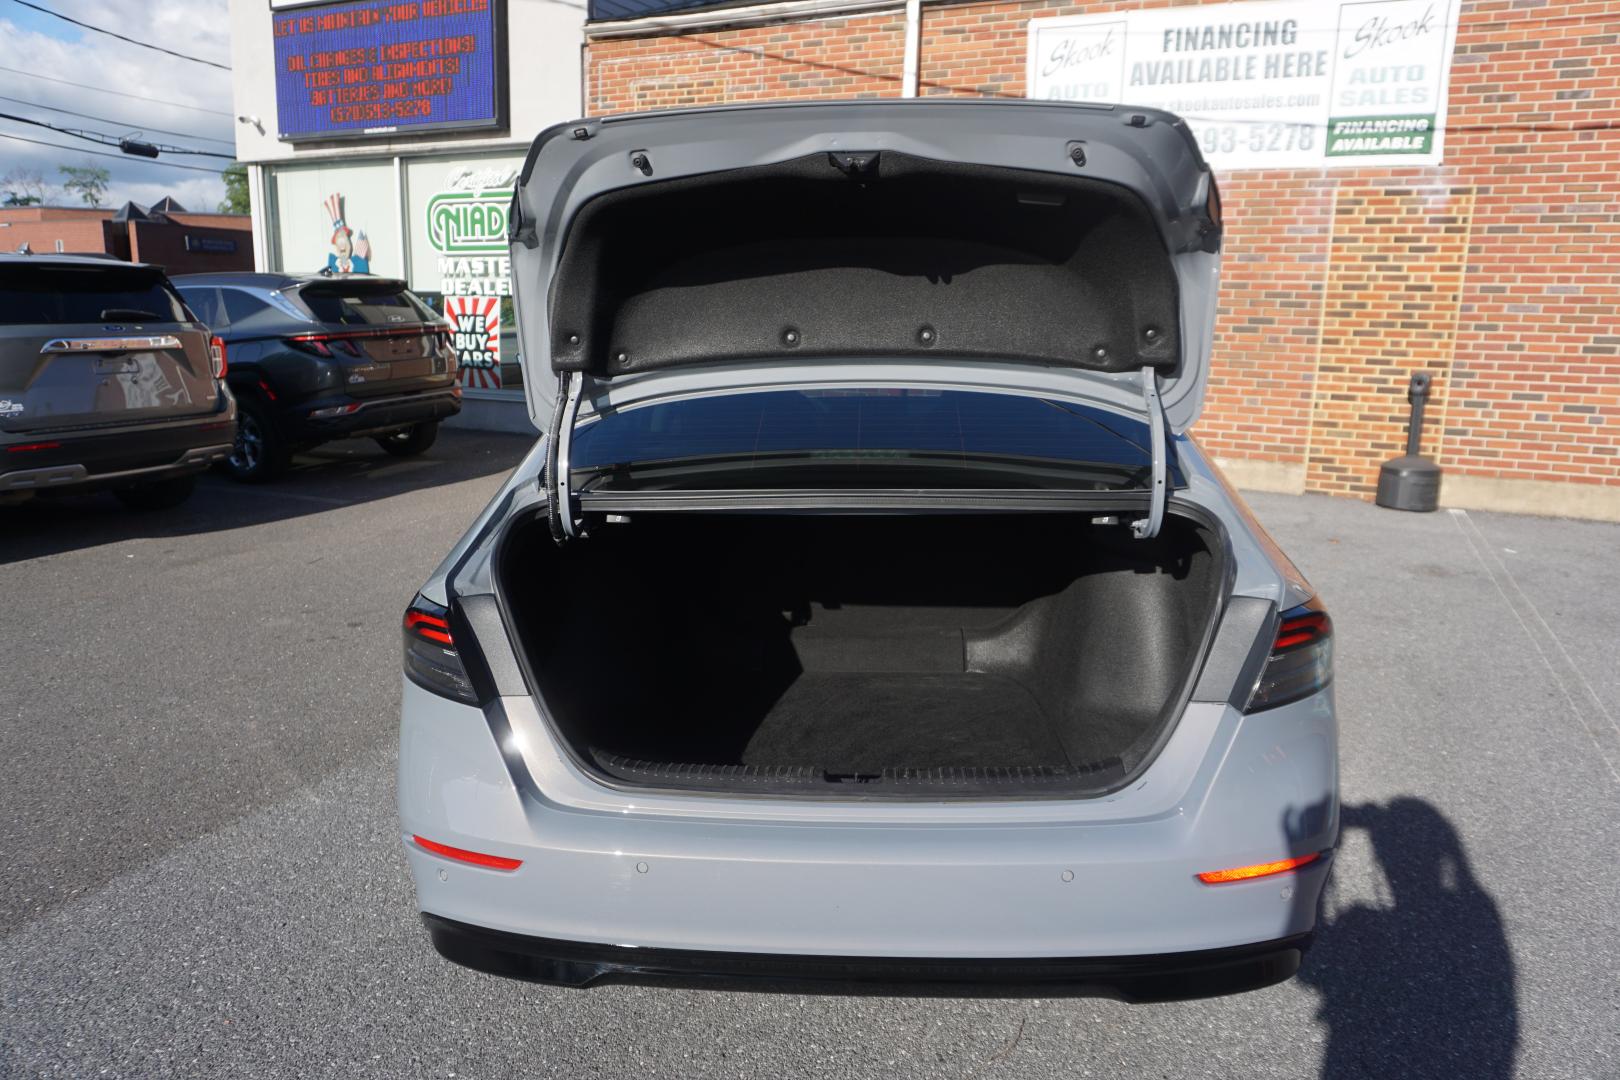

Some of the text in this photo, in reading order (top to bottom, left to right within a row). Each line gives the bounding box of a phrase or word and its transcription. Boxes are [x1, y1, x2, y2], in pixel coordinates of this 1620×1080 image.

[273, 18, 296, 36] LET
[384, 3, 419, 25] YOUR
[1163, 19, 1298, 52] FINANCING
[1343, 3, 1435, 59] Skook
[310, 48, 365, 69] CHANGES
[1042, 28, 1115, 77] Skook
[344, 67, 369, 85] AND
[1130, 50, 1328, 86] AVAILABLE HERE
[1348, 64, 1427, 85] AUTO
[311, 85, 380, 106] BATTERIES
[383, 81, 409, 99] AND
[1047, 82, 1110, 100] AUTO
[1338, 87, 1429, 107] SALES
[1332, 118, 1430, 135] FINANCING
[1193, 123, 1315, 154] 93-5278
[1331, 135, 1425, 152] AVAILABLE
[434, 205, 511, 248] NIAD
[439, 256, 511, 274] MASTE
[440, 278, 513, 295] DEALE
[456, 315, 486, 333] WE
[455, 333, 488, 350] BUY
